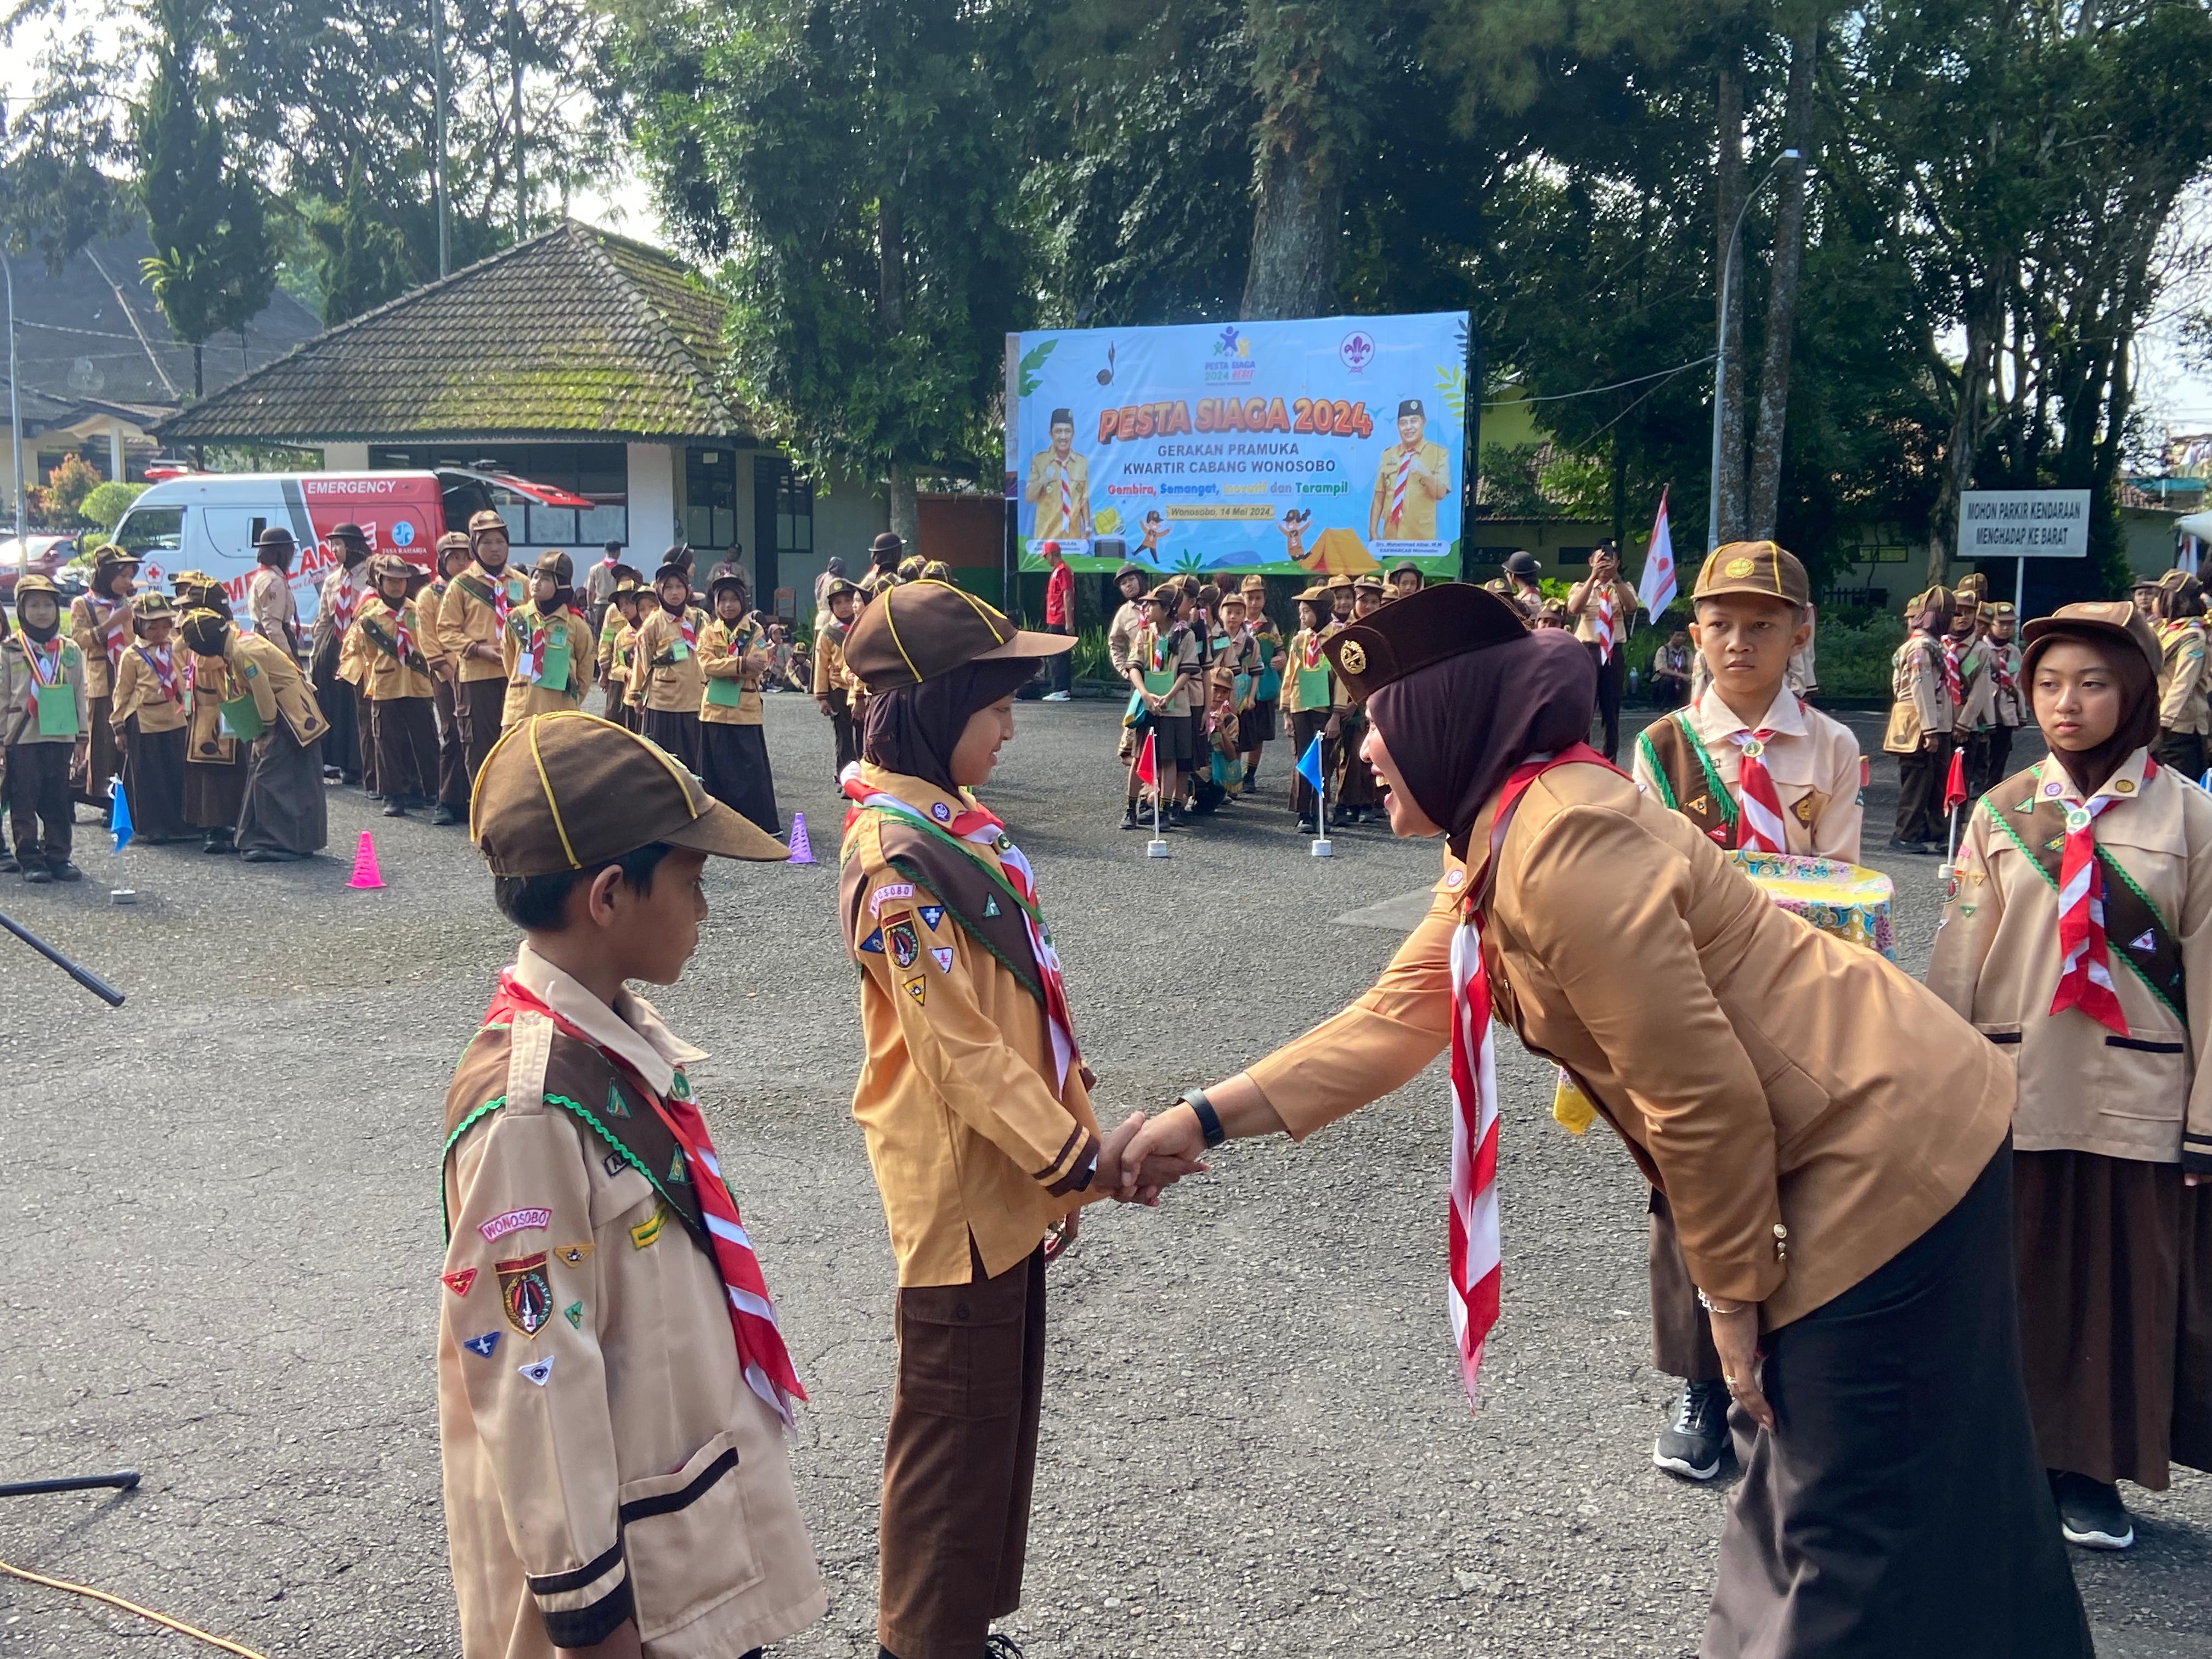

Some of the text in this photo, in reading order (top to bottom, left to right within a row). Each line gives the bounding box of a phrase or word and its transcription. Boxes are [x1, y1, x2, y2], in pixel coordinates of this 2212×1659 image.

[1098, 396, 1373, 445] PESTA SIAGA 2024
[1158, 443, 1299, 456] GERAKAN PRAMUKA
[1124, 459, 1335, 475] KWARTIR CABANG WONOSOBO
[307, 481, 396, 494] EMERGENCY
[1108, 484, 1157, 496] Gembira,
[1160, 483, 1220, 496] Semangat,
[1270, 481, 1292, 493] dan
[1295, 481, 1348, 496] Terampil
[1171, 507, 1217, 517] Wonosobo,
[1233, 507, 1247, 516] Mei
[1249, 507, 1270, 516] 2024
[1967, 501, 2081, 520] MOHON PARKIR KENDARAAN
[1976, 527, 2069, 545] MENGHADAP KE BARAT
[484, 1210, 546, 1239] WONOSOBO
